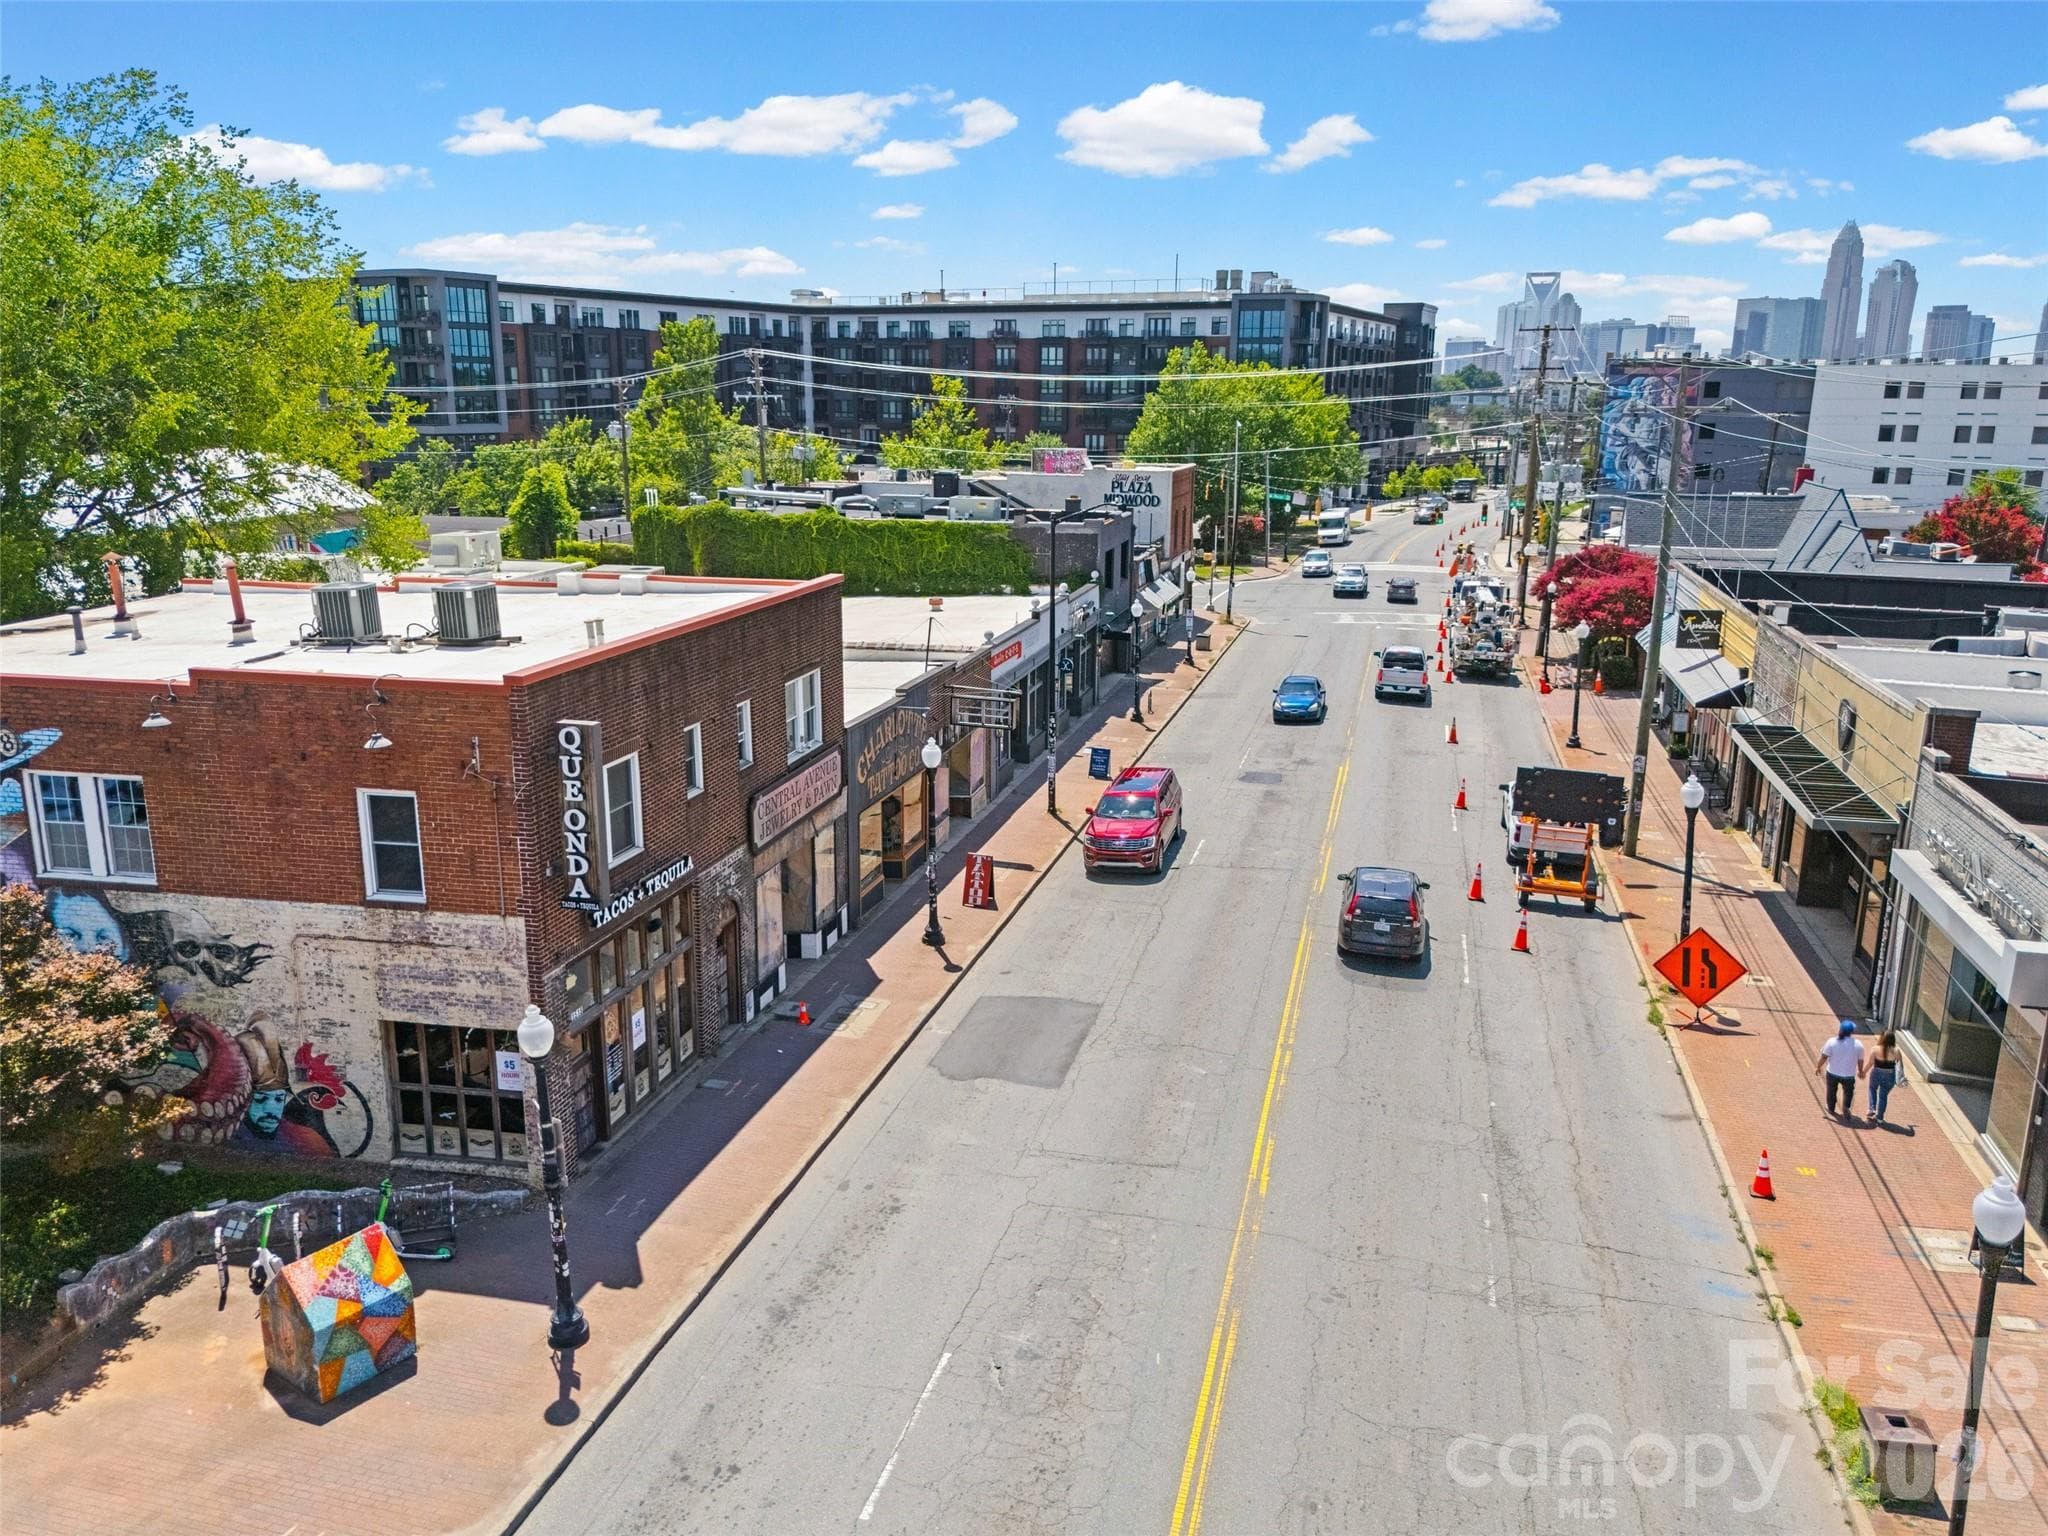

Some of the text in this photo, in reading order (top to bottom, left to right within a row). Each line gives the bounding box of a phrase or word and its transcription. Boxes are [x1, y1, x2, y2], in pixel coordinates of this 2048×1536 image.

[1104, 494, 1161, 507] MIDWOOD
[1111, 481, 1153, 494] PLAZA
[857, 709, 928, 784] CHARLOTTE
[757, 755, 838, 820] CENTRAL AVENUE
[759, 774, 838, 841] JEWELRY & PAWN
[593, 887, 636, 928] TACOS
[637, 889, 645, 901] +
[646, 856, 694, 895] TEQUILA
[503, 1060, 516, 1070] $5
